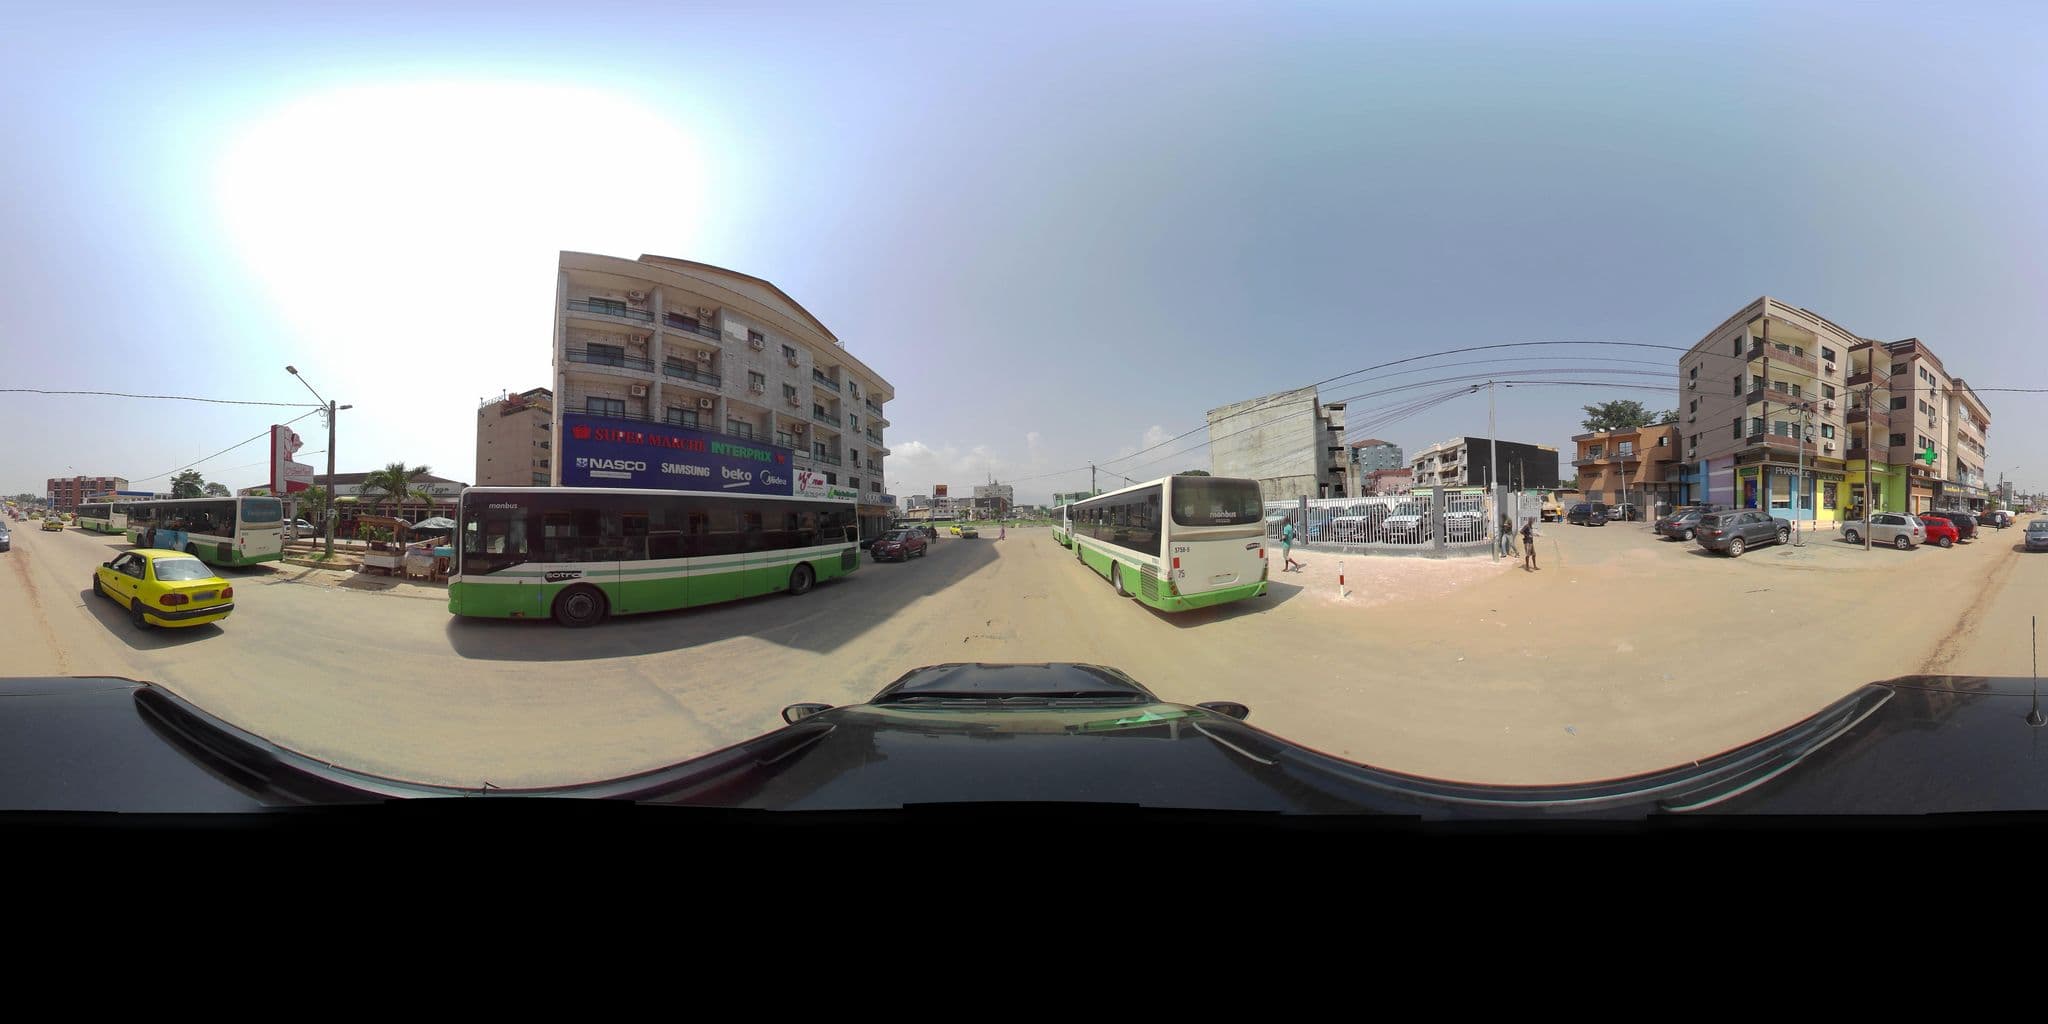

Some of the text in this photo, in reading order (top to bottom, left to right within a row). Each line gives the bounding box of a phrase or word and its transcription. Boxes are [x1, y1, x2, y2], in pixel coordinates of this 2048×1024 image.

[595, 428, 644, 446] SUPER
[711, 441, 772, 462] INTERPRIX
[590, 458, 647, 471] NASCO
[661, 463, 711, 477] SAMSUNG
[721, 466, 753, 481] beko
[488, 501, 518, 509] monbus
